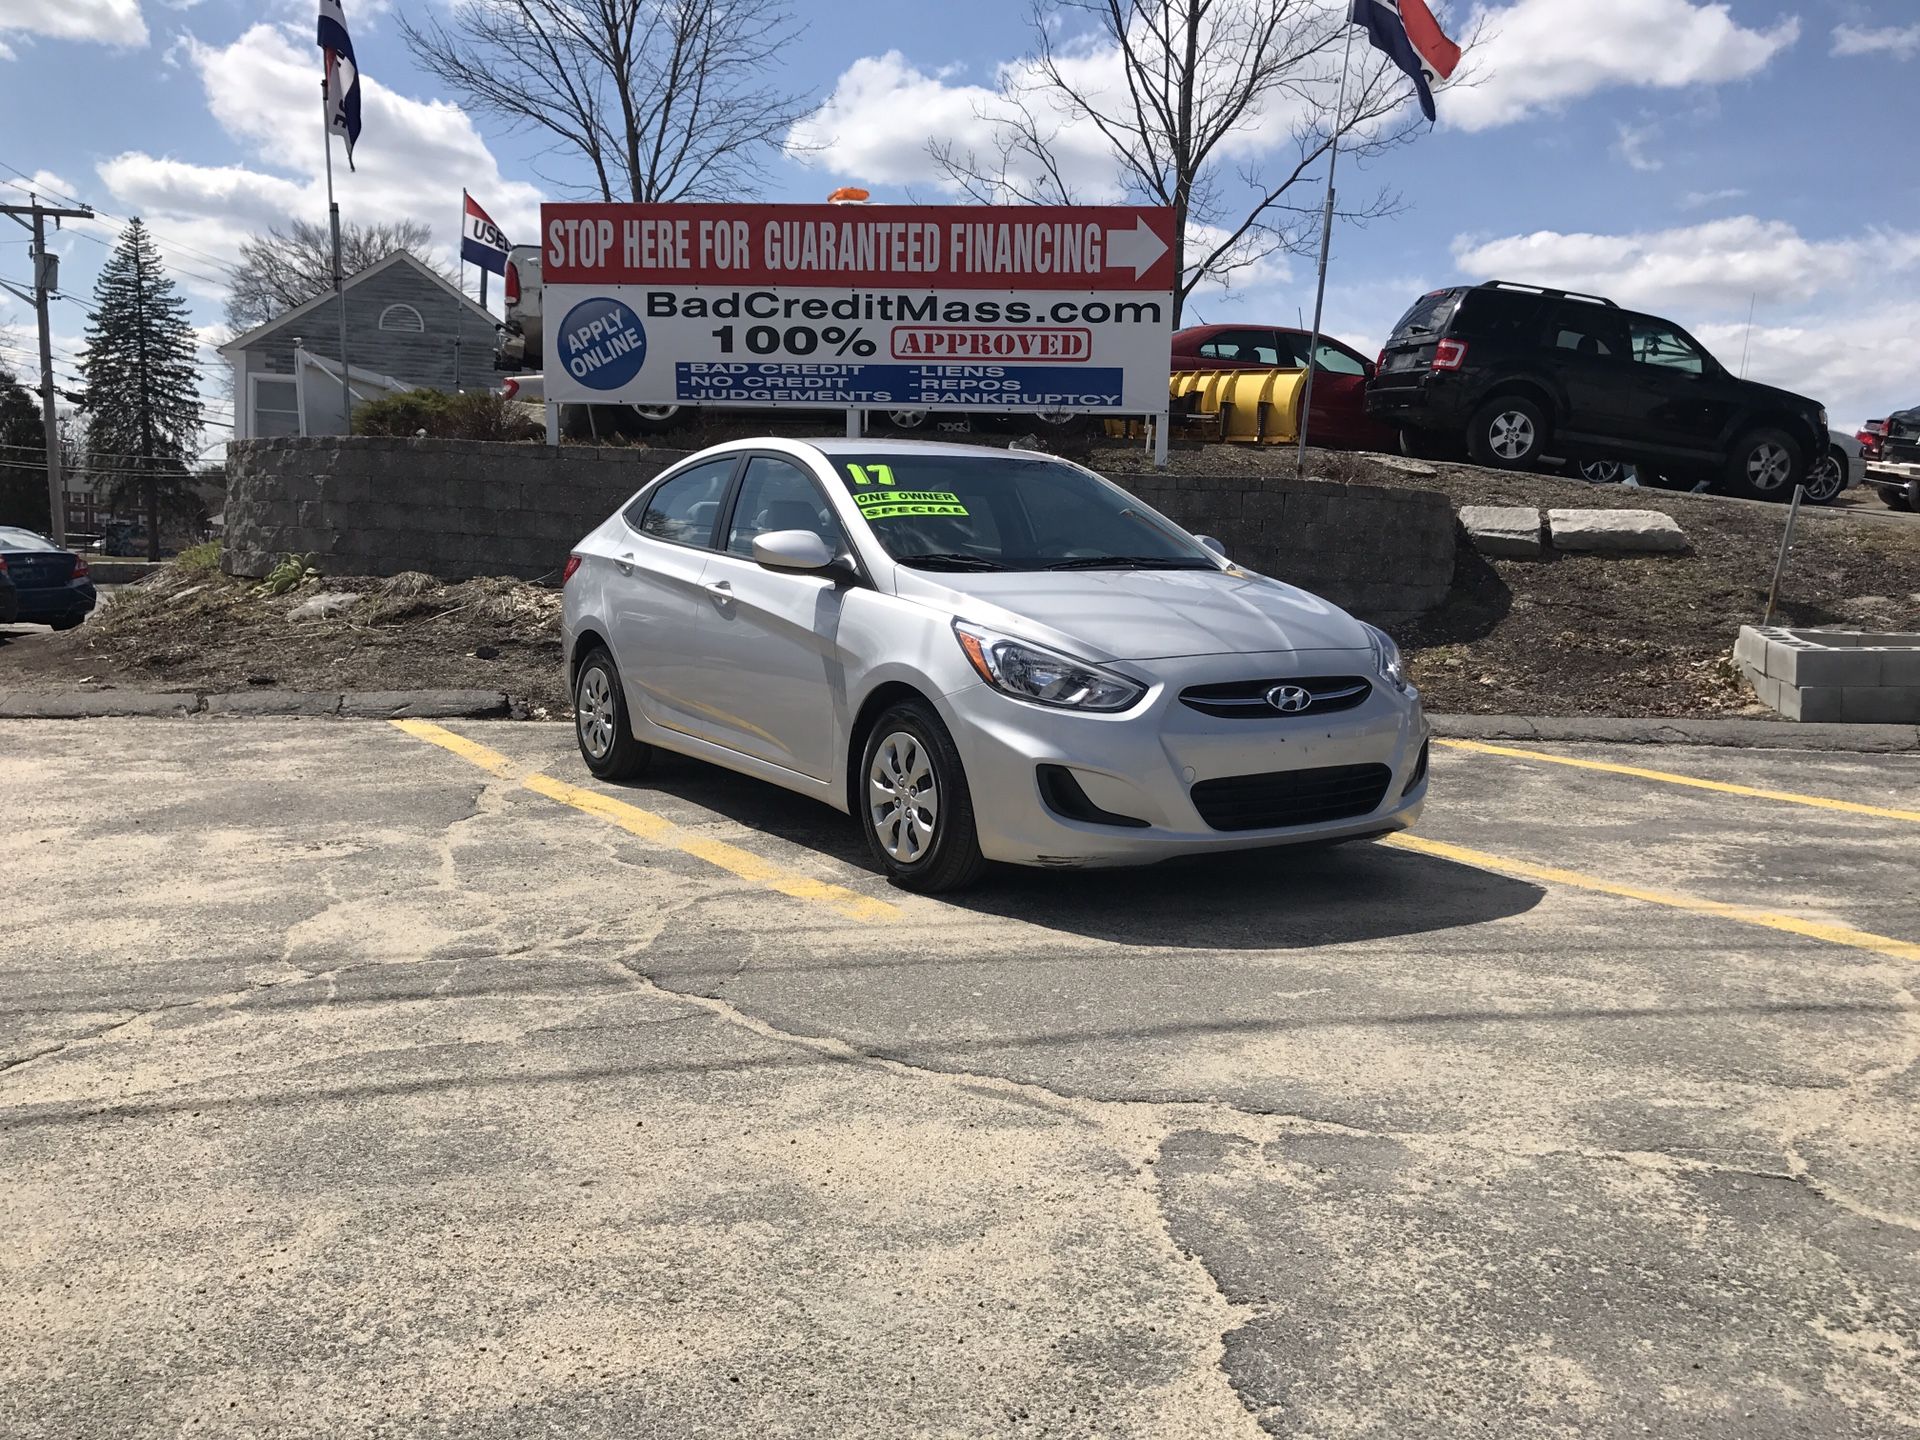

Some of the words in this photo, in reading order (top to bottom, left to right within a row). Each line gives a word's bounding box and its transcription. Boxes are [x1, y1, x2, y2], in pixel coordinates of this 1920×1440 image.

[548, 218, 614, 269] STOP
[622, 219, 691, 269] HERE
[699, 219, 750, 270] FOR
[764, 220, 940, 272] GUARANTEED
[950, 222, 1102, 274] FINANCING
[647, 290, 1161, 324] BadCreditMass.com
[567, 308, 624, 354] APPLY
[712, 325, 877, 357] 100%
[899, 333, 1083, 355] APPROVED
[570, 327, 643, 378] ONLINE
[743, 377, 849, 388] CREDIT
[758, 363, 865, 376] CREDIT
[846, 463, 896, 486] 17
[857, 493, 891, 503] ONE
[898, 492, 954, 501] OWNER
[865, 506, 966, 517] SPECIAL
